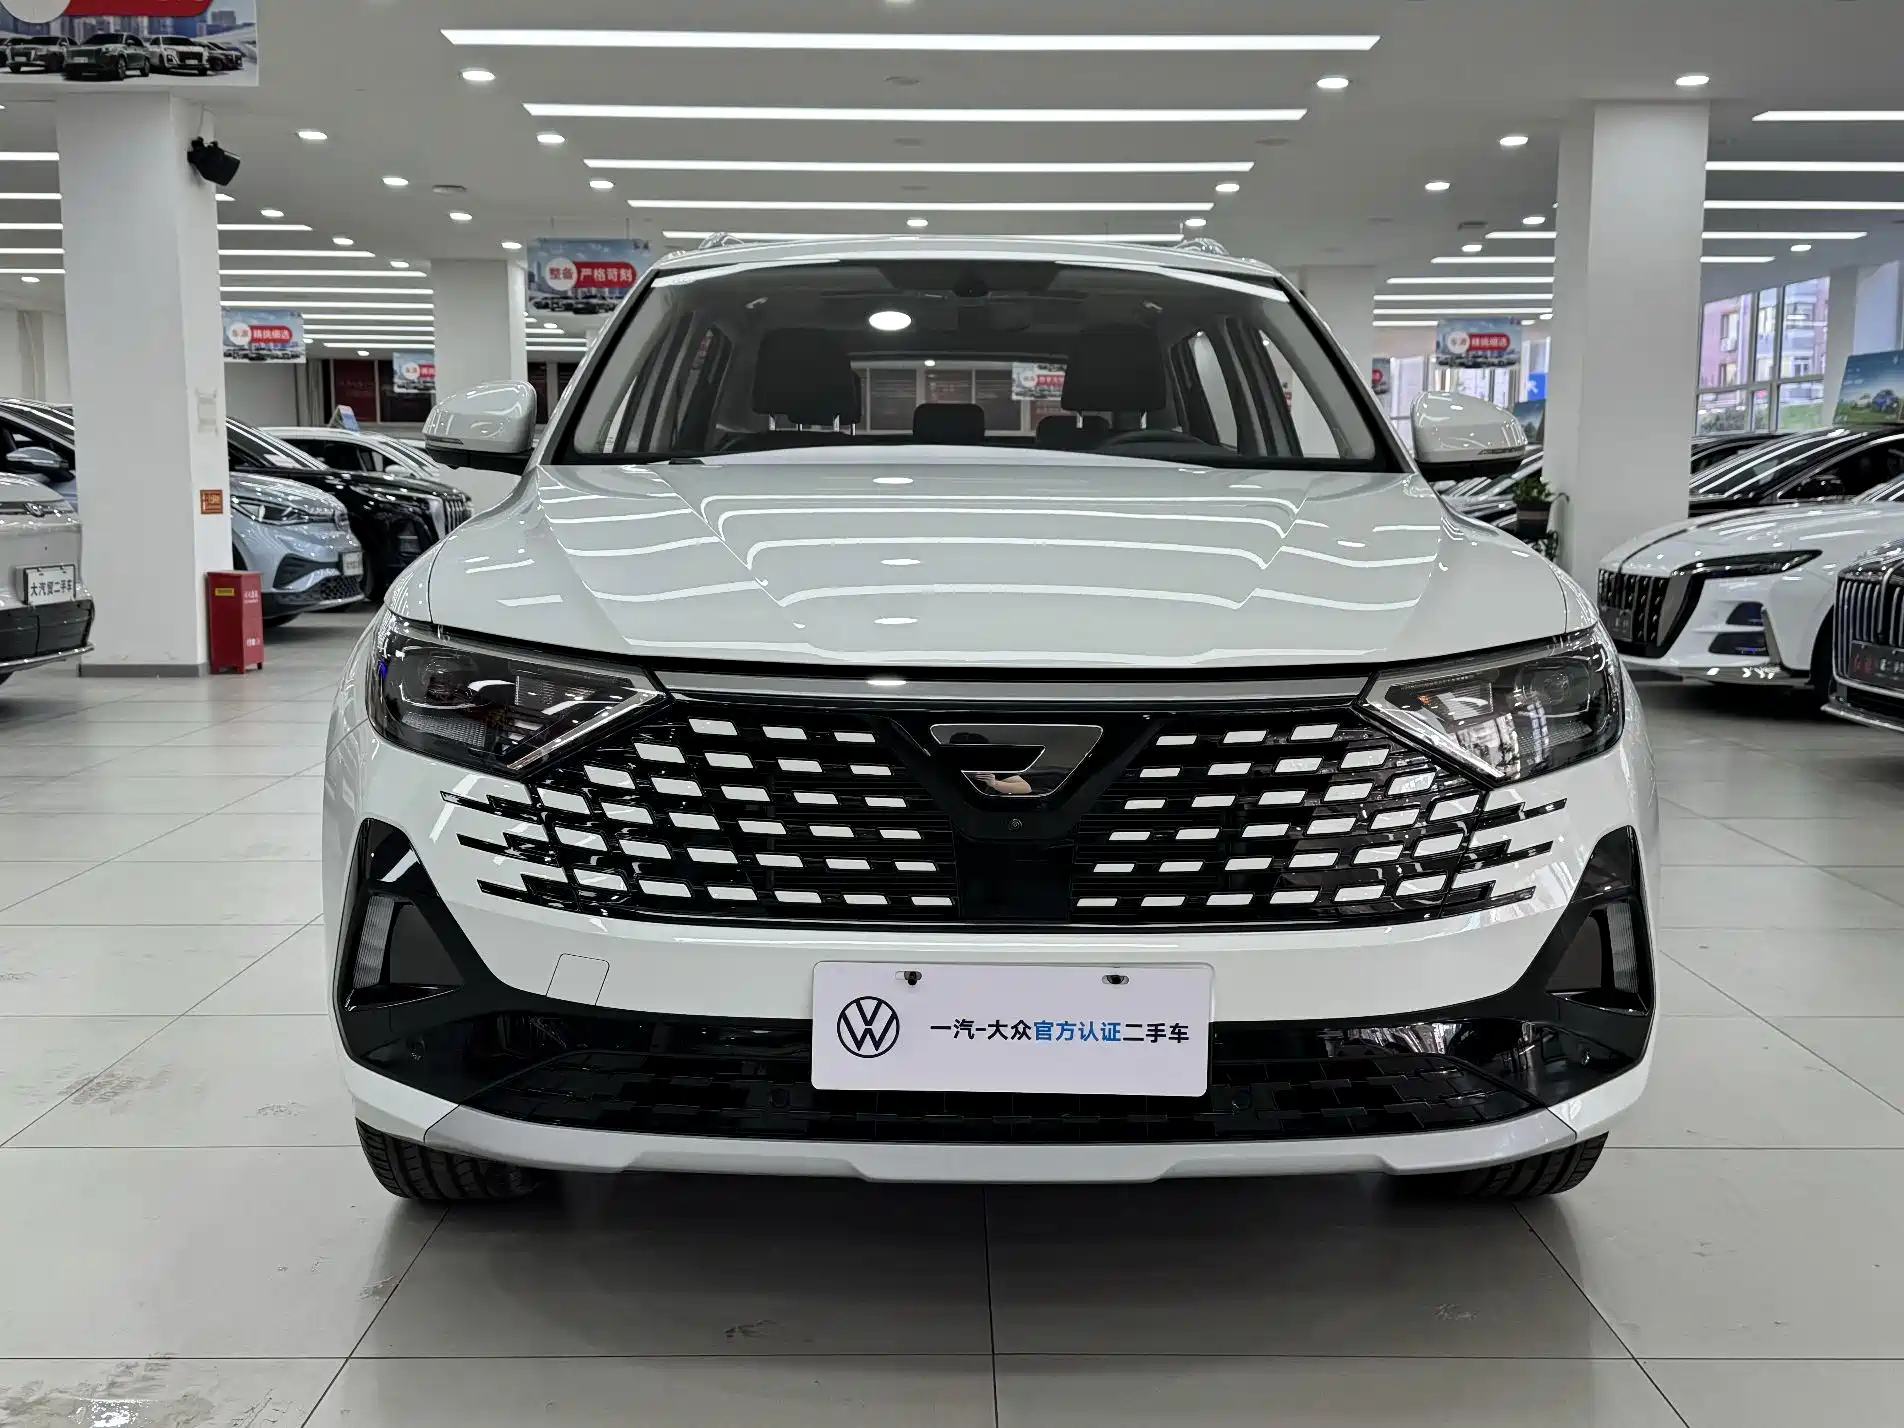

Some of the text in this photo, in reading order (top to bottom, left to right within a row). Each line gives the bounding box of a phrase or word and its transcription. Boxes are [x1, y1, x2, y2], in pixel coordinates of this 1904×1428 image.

[580, 267, 632, 282] 严格苛刻
[930, 1018, 1189, 1044] 一汽-大众官方认证二手车
